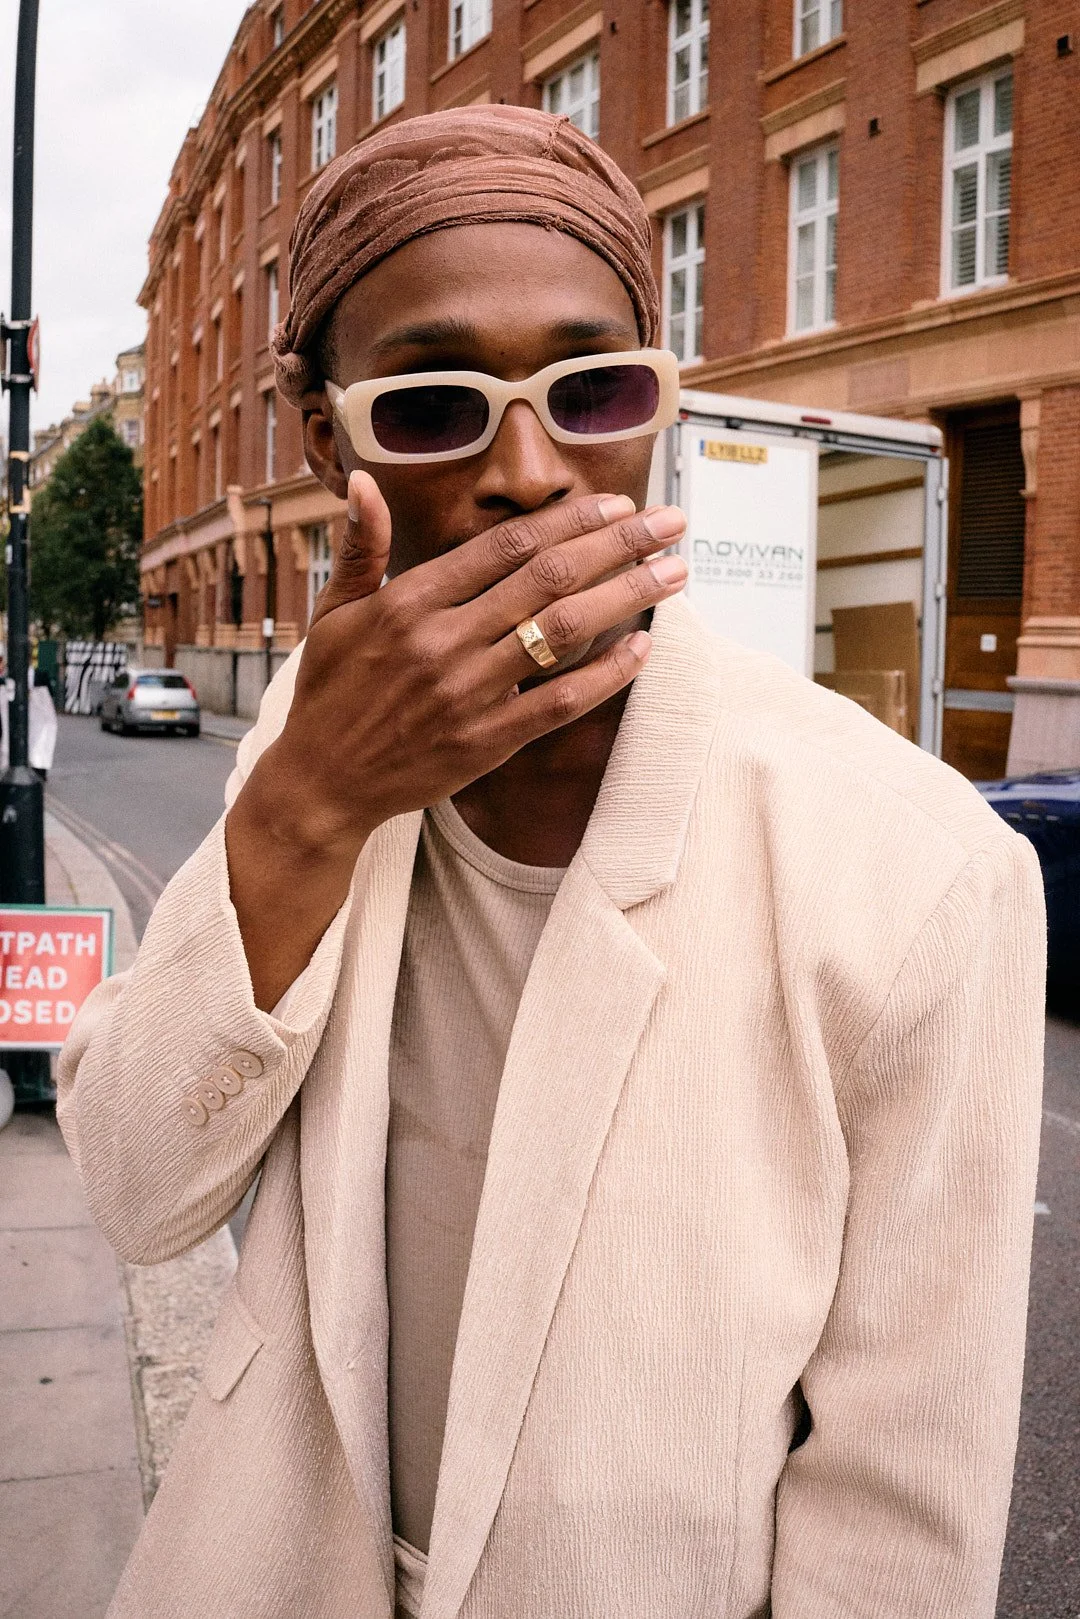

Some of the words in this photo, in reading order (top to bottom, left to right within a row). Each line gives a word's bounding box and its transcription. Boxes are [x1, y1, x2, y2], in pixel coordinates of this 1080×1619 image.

[693, 539, 804, 560] NOVIVAN
[0, 931, 96, 956] TPATH
[0, 965, 68, 990] EAD
